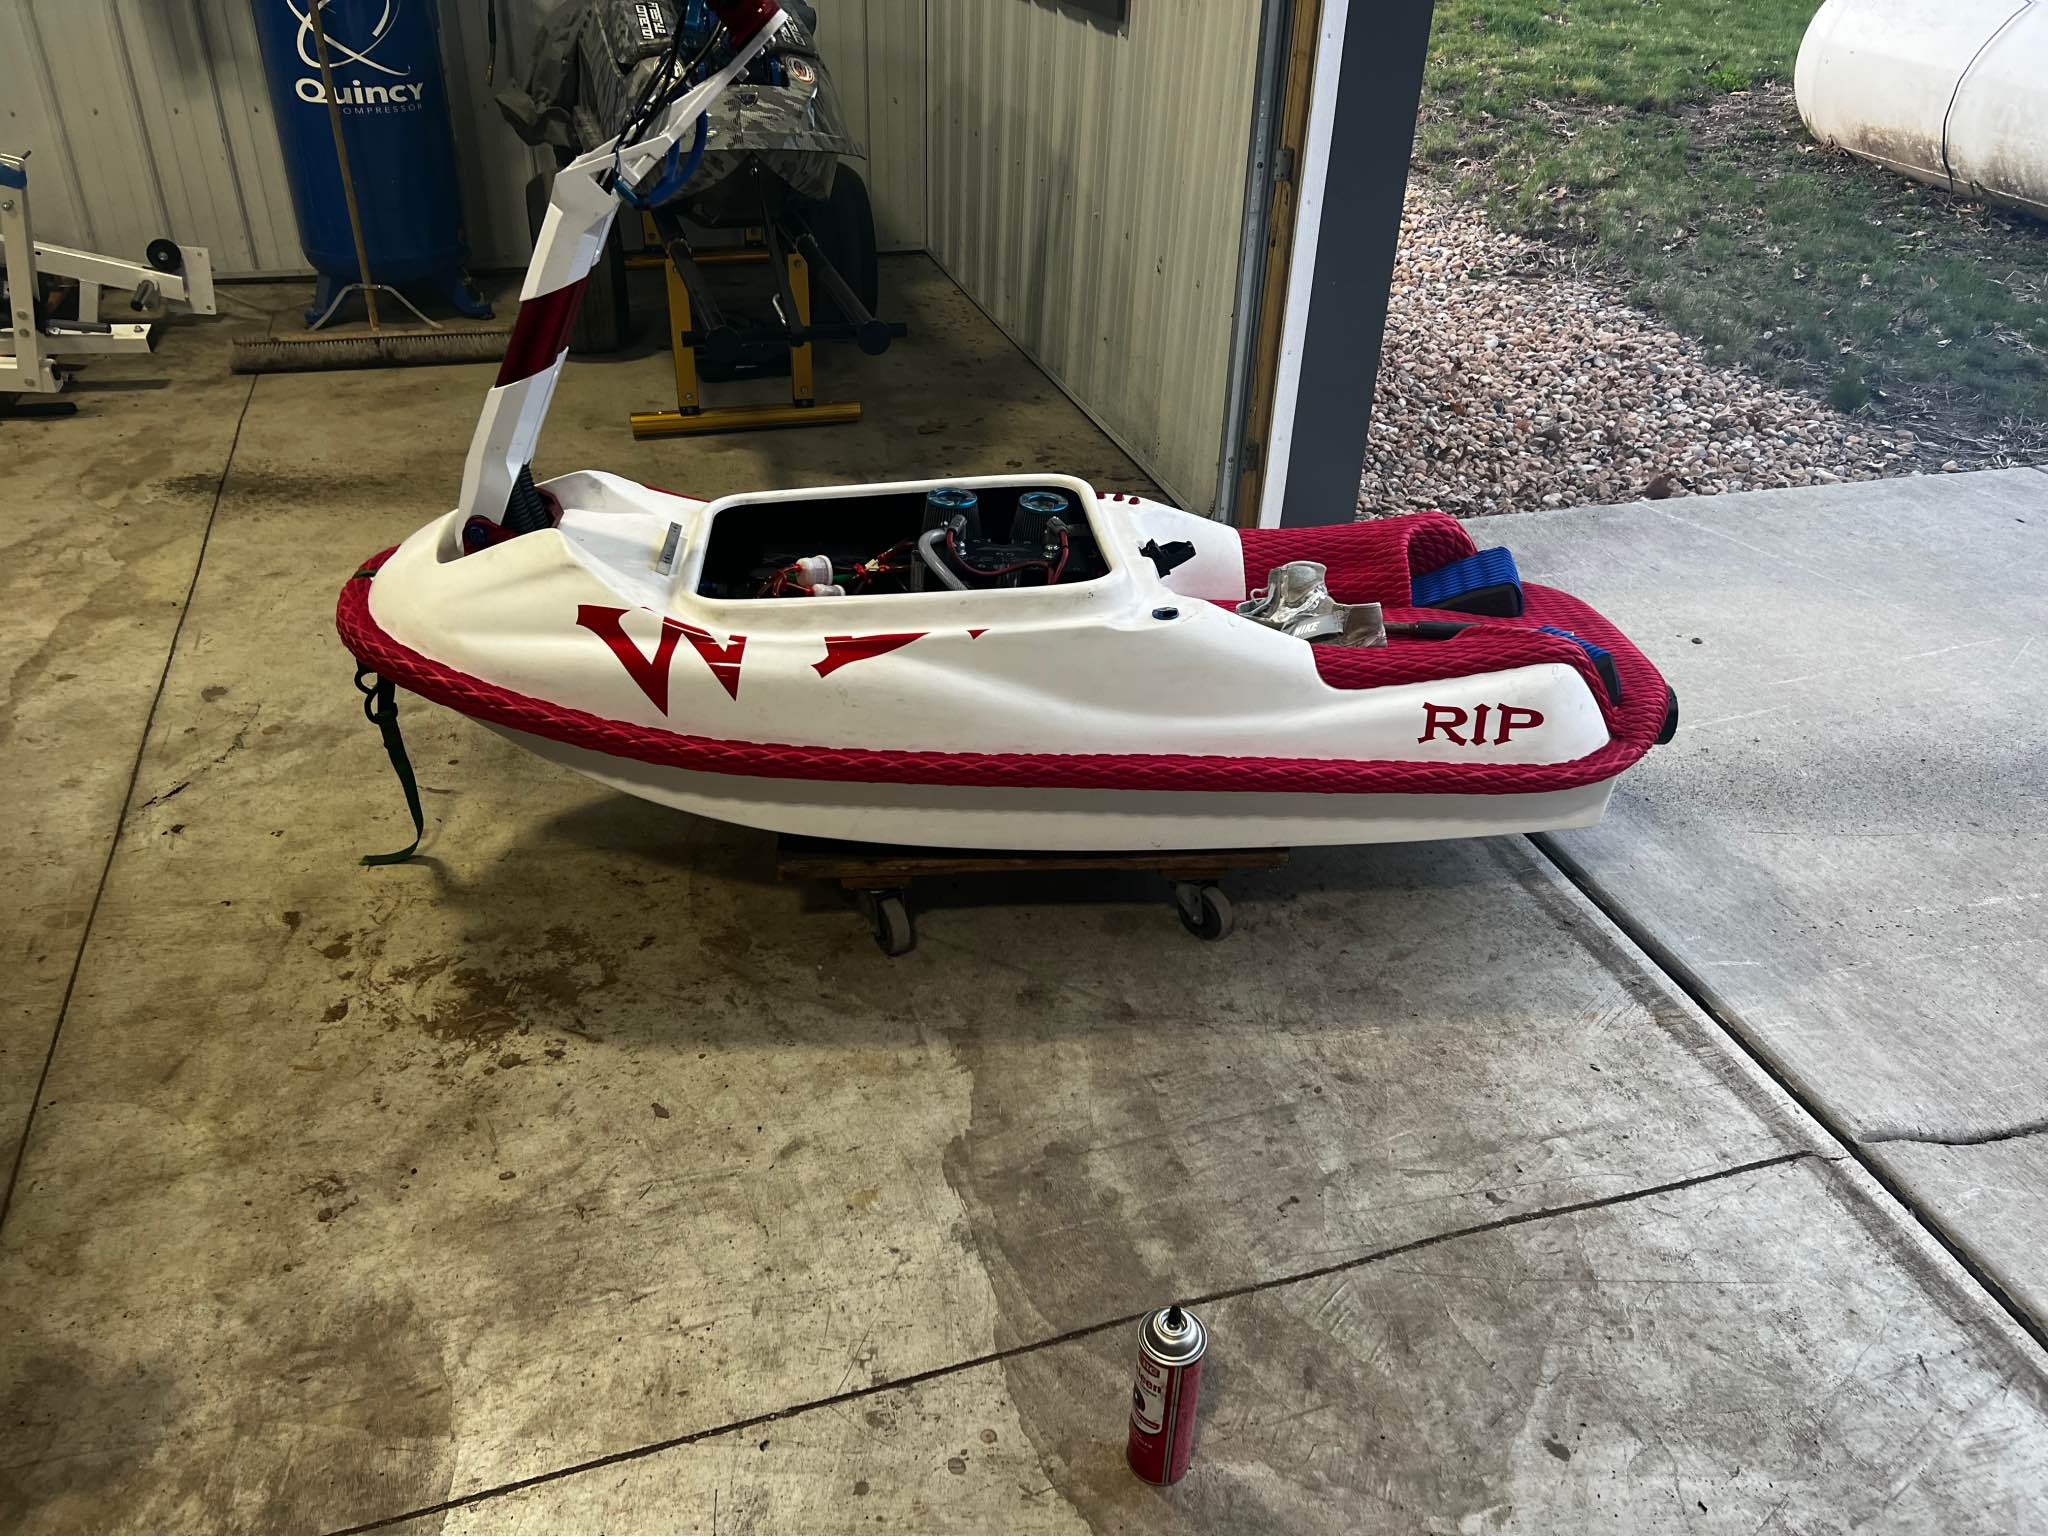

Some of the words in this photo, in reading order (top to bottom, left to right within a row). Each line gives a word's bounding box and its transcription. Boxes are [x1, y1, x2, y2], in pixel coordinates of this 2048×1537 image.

[340, 104, 422, 115] OMPRESSOR
[1294, 621, 1320, 637] NIKE
[1417, 701, 1545, 746] RIP
